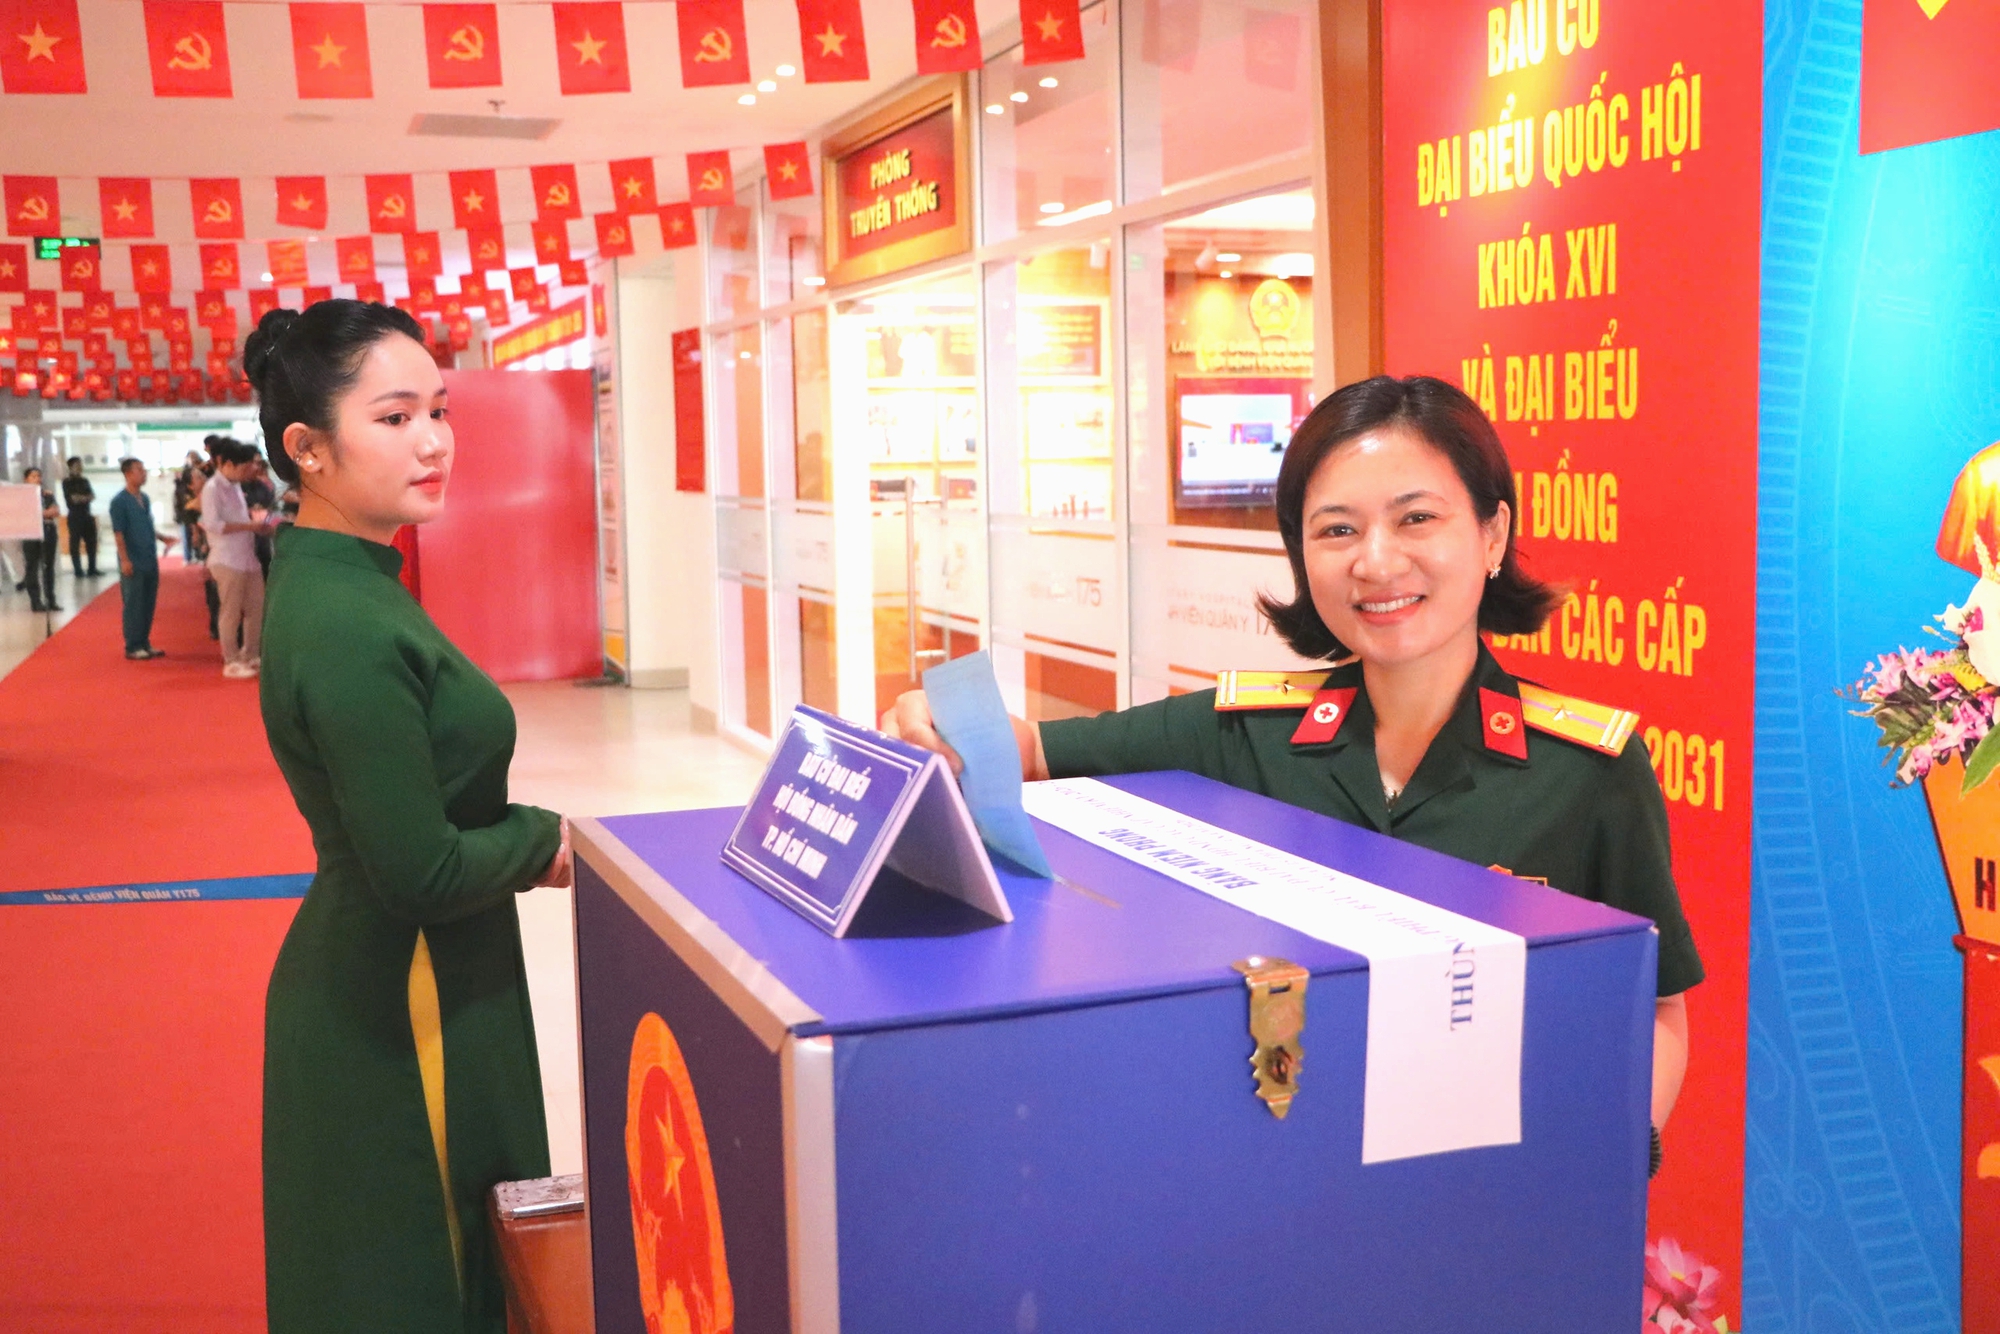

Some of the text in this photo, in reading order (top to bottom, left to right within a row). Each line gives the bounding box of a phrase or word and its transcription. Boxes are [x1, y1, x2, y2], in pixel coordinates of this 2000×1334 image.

[870, 148, 910, 190] PHÒNG
[1417, 61, 1701, 217] ĐẠI BIỂU QUỐC HỘI
[851, 180, 938, 238] TRUYỀN THỐNG
[1478, 221, 1616, 309] KHÓA XVI
[1505, 353, 1554, 436] ĐẠI
[1564, 318, 1638, 420] BIỂU
[1532, 448, 1617, 543] ĐỒNG
[1561, 579, 1624, 666] CÁC
[1636, 576, 1706, 677] CẤP
